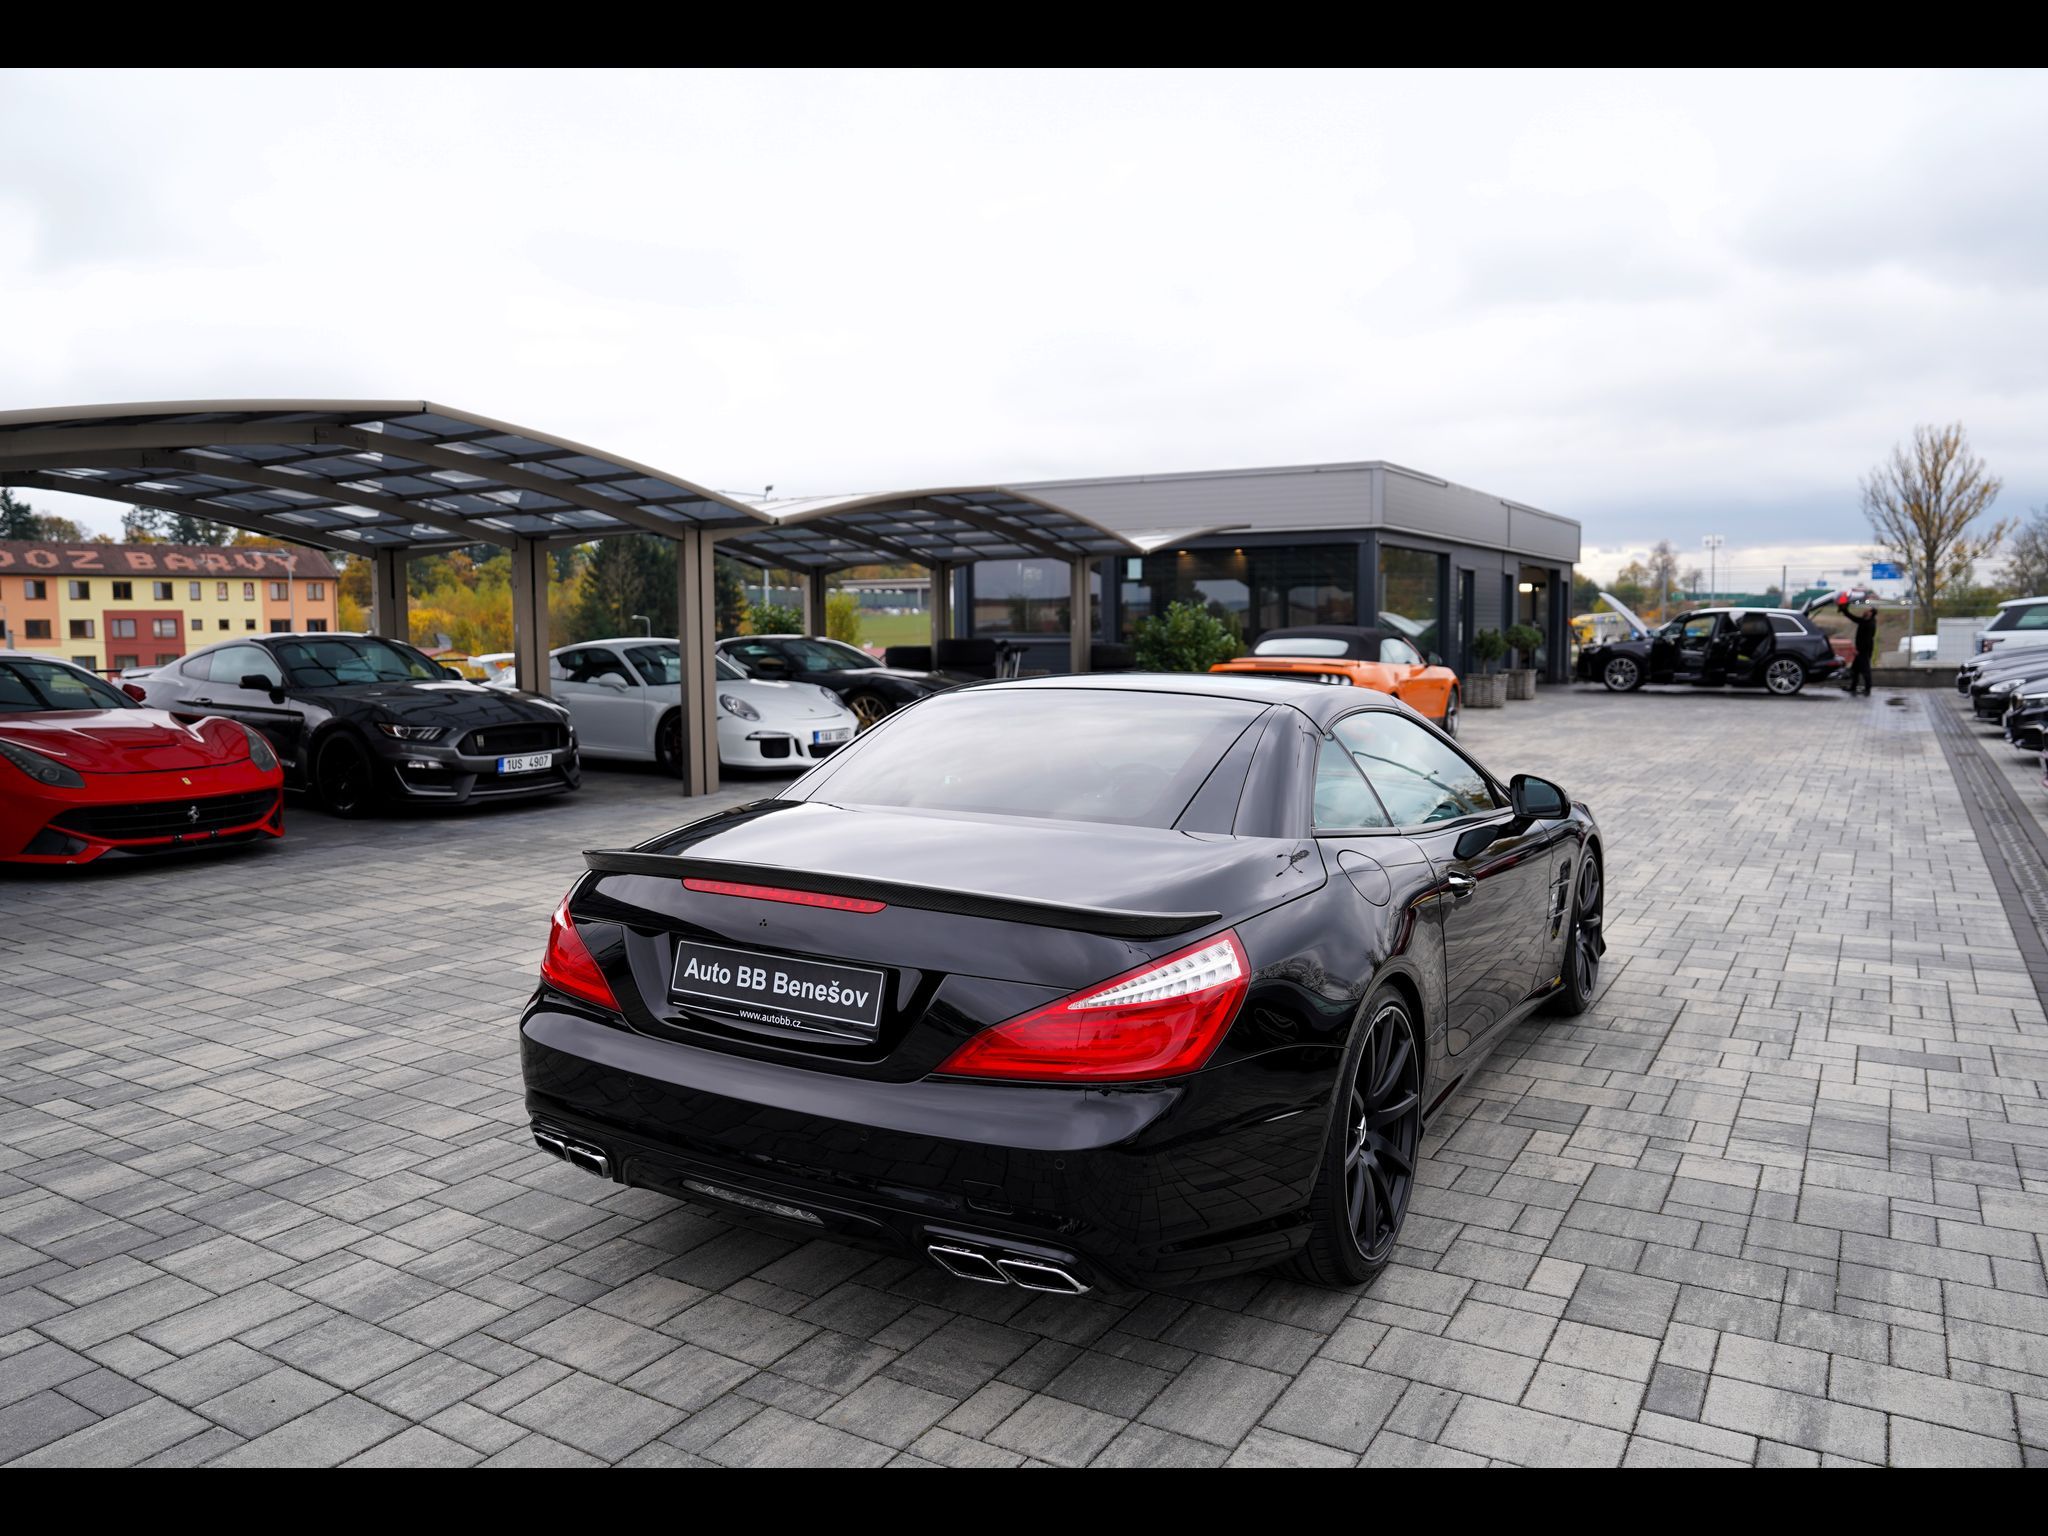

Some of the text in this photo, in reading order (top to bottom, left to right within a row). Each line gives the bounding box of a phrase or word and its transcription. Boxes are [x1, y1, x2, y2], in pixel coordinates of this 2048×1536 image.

[124, 551, 298, 572] BARVY
[507, 755, 549, 770] 1US 4907
[684, 957, 869, 1008] Auto BB Benešov
[739, 1009, 801, 1028] www.autobb.cz
